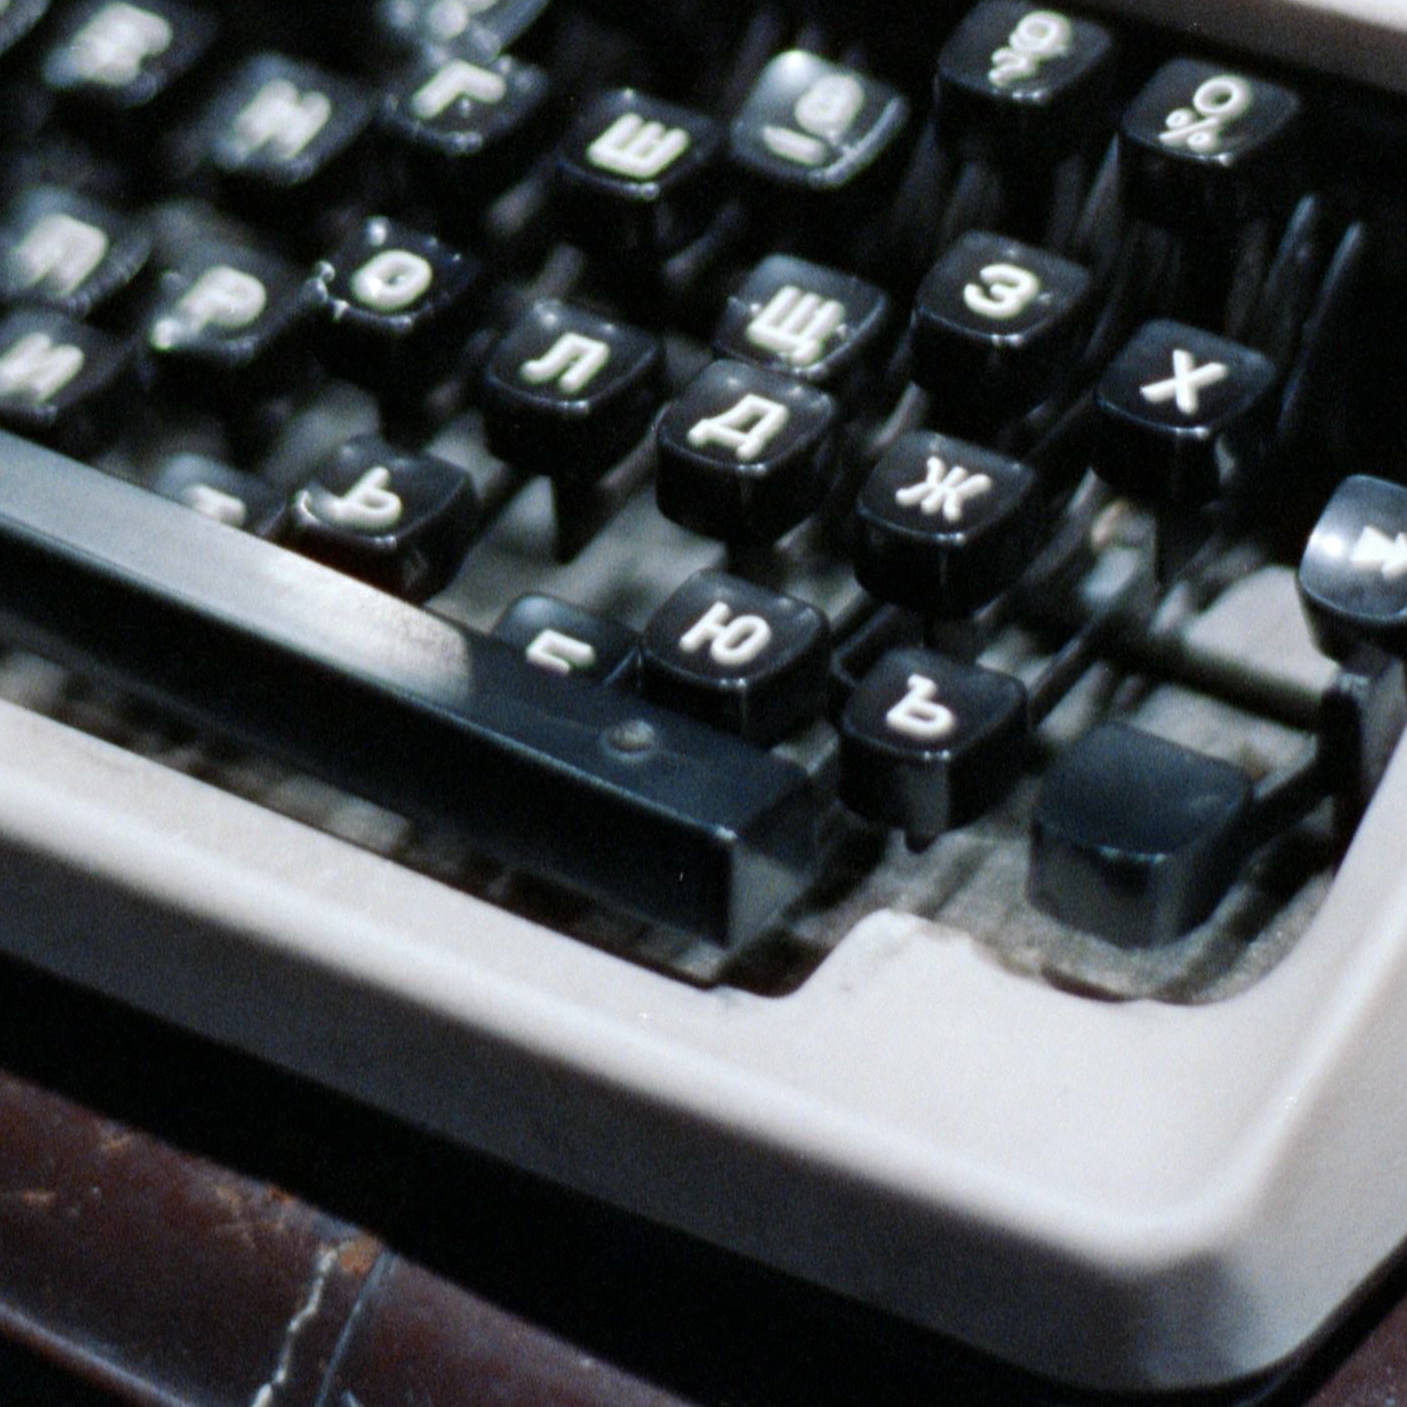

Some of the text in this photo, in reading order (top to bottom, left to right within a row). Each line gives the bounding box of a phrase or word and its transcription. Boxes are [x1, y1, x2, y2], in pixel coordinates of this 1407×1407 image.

[587, 112, 689, 178] Ш
[350, 248, 433, 310] О
[746, 284, 847, 366] Щ
[520, 331, 610, 392] Л
[1139, 348, 1228, 414] Х
[688, 393, 790, 459] Д
[895, 455, 991, 521] Ж
[679, 600, 772, 665] Ю
[884, 672, 956, 738] Ъ
